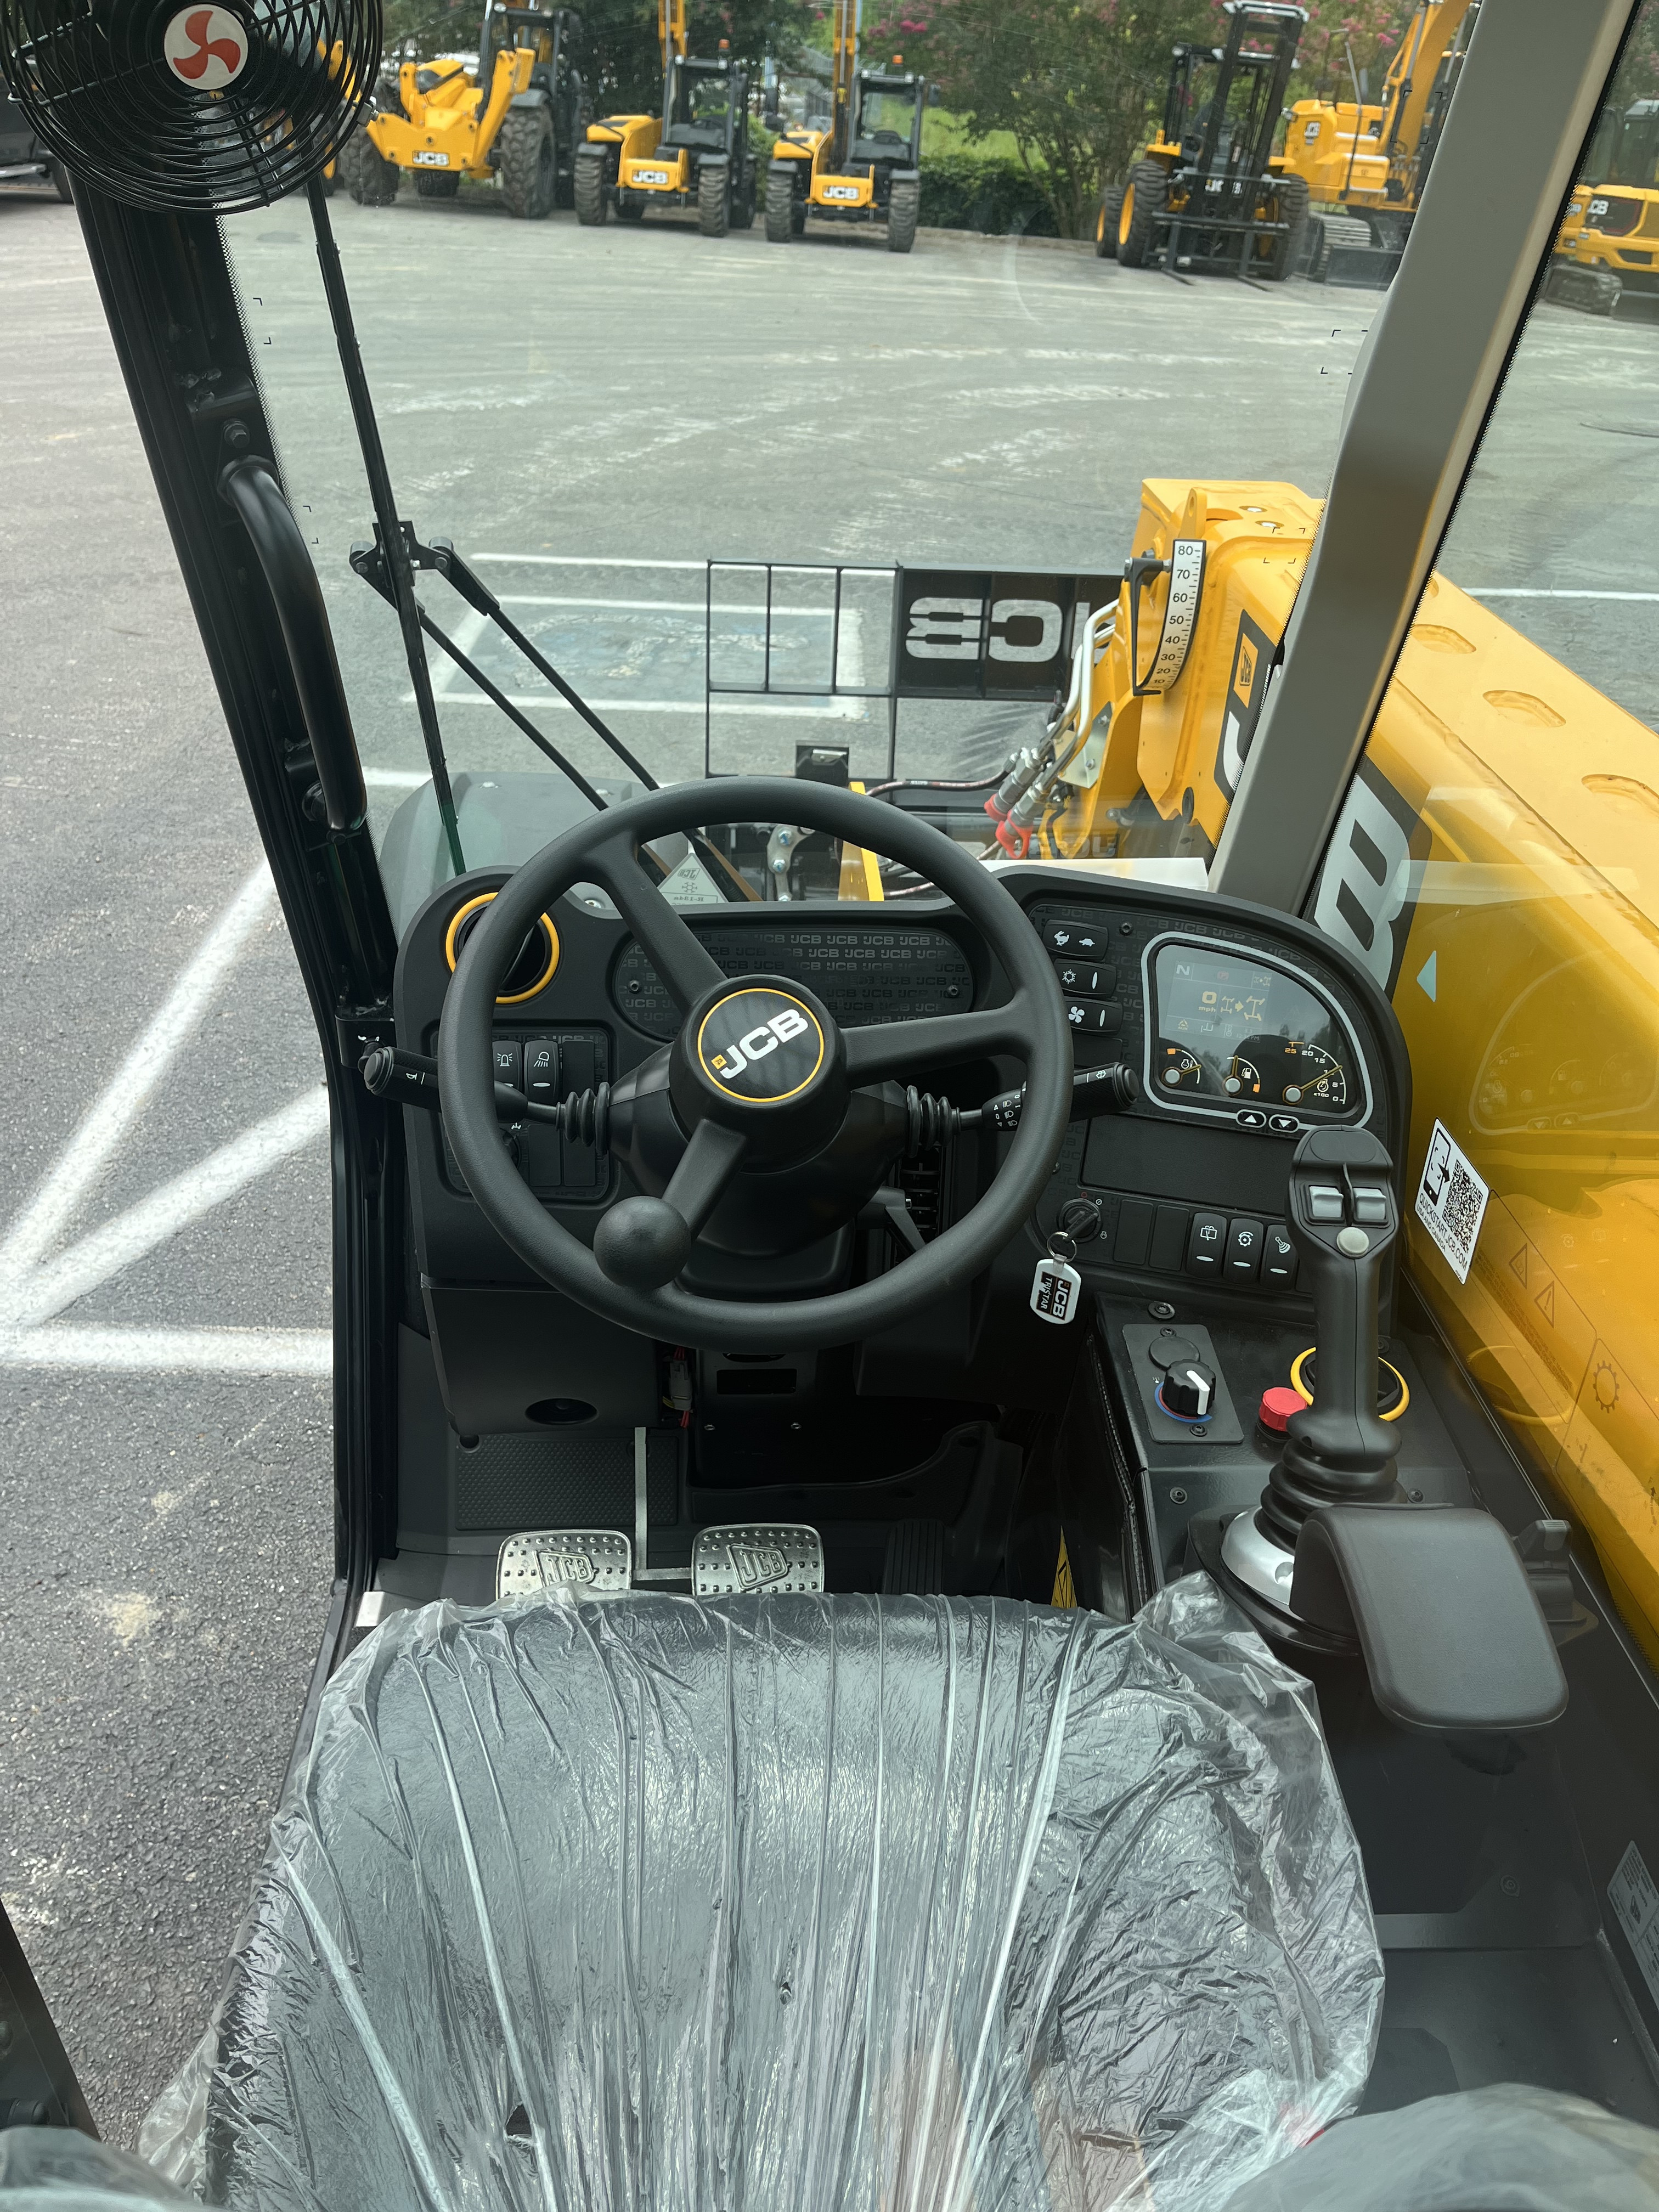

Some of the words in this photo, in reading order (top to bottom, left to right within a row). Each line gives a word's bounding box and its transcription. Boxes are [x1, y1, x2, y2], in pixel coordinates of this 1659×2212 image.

[413, 151, 449, 166] JCB
[633, 170, 668, 184] JCB
[823, 185, 859, 200] JCB
[1178, 546, 1193, 555] 80
[1177, 569, 1190, 579] 70
[1173, 593, 1187, 602] 60
[1169, 616, 1184, 624] 50
[1165, 636, 1180, 644] 40
[791, 935, 821, 944] JCB
[827, 935, 857, 945] JCB
[863, 936, 894, 945] JCB
[899, 936, 930, 946] JCB
[808, 948, 839, 958] JCB
[844, 949, 876, 958] JCB
[881, 949, 911, 959] JCB
[826, 962, 857, 971] JCB
[1176, 964, 1190, 975] N
[625, 999, 657, 1008] JCB
[1201, 991, 1217, 1005] 0
[720, 1009, 809, 1079] JCB
[1420, 1192, 1468, 1272] QUICKSTART.JCB.COM
[1424, 1216, 1432, 1230] AND
[1431, 1226, 1447, 1253] CANADA
[1052, 1280, 1069, 1317] JCB
[546, 1556, 588, 1583] JCB
[739, 1547, 783, 1583] JCB
